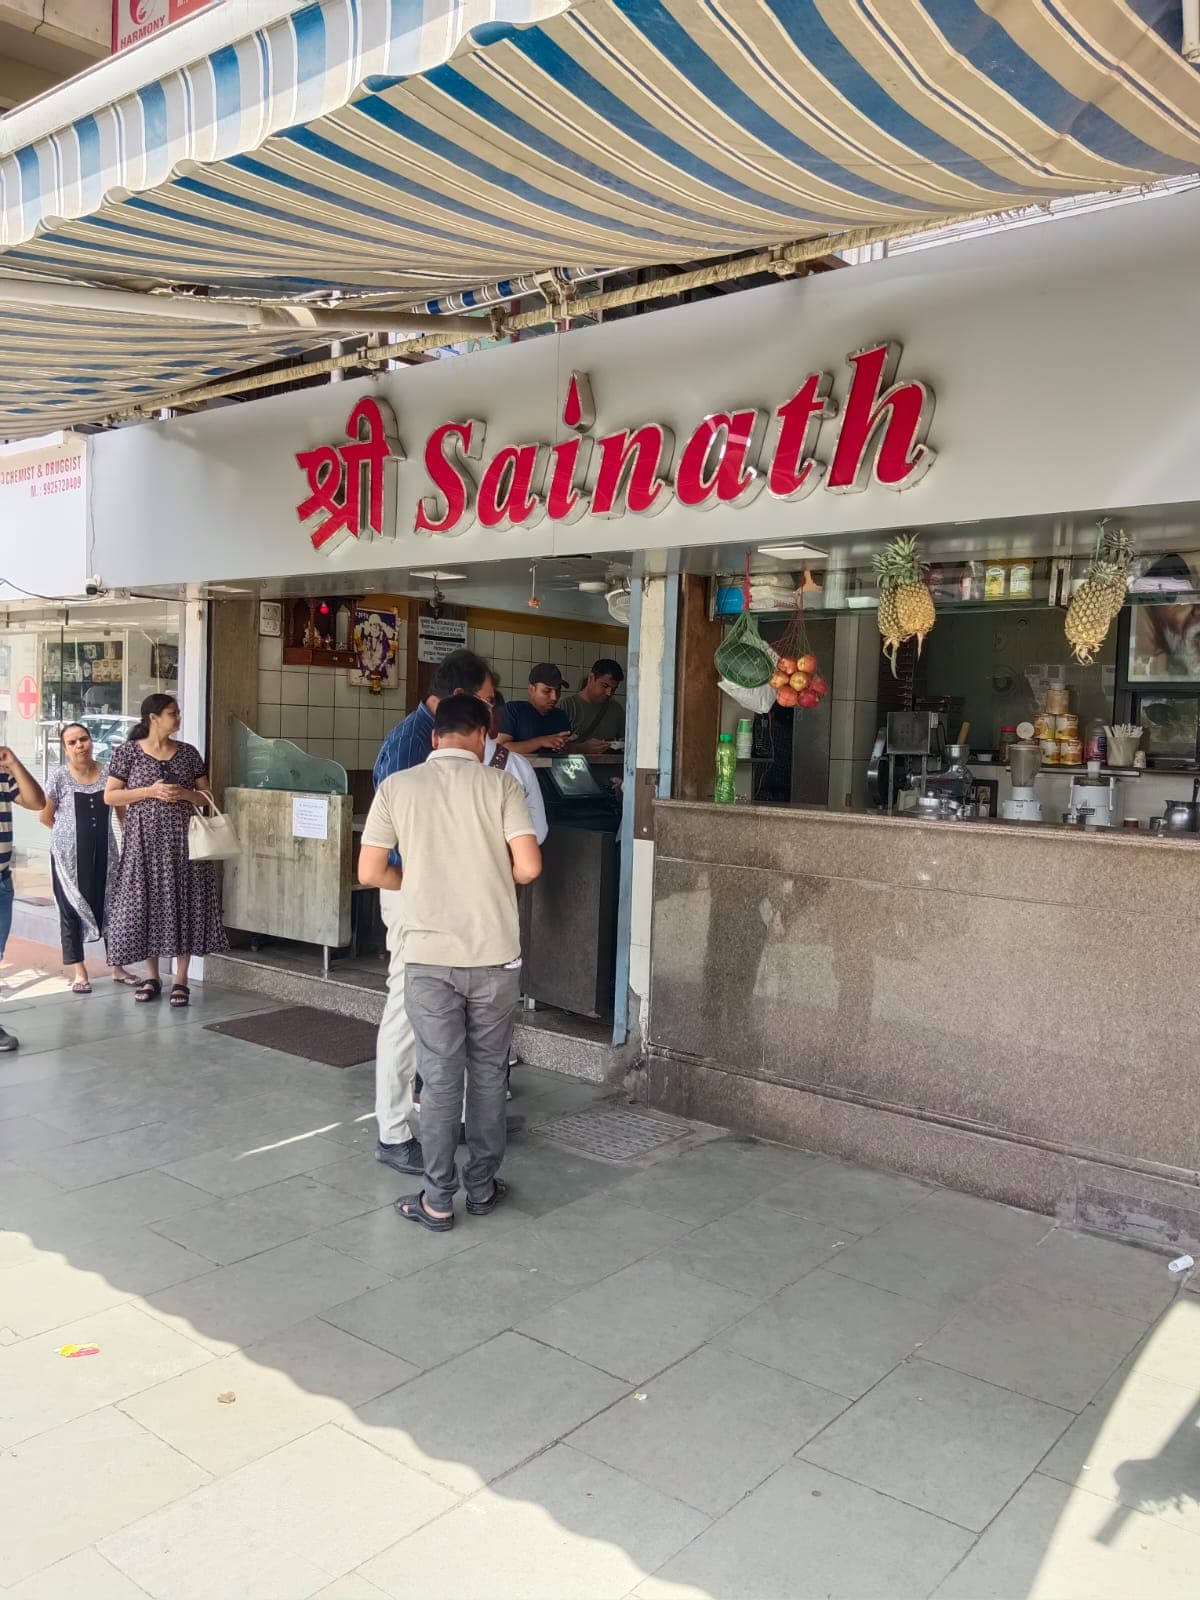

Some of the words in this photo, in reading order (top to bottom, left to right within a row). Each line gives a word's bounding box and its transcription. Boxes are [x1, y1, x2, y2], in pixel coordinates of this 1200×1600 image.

[120, 15, 166, 49] HARMONY
[37, 464, 43, 478] &
[45, 456, 81, 476] DRUGGIST
[296, 395, 398, 551] श्री
[414, 343, 933, 534] Sainath
